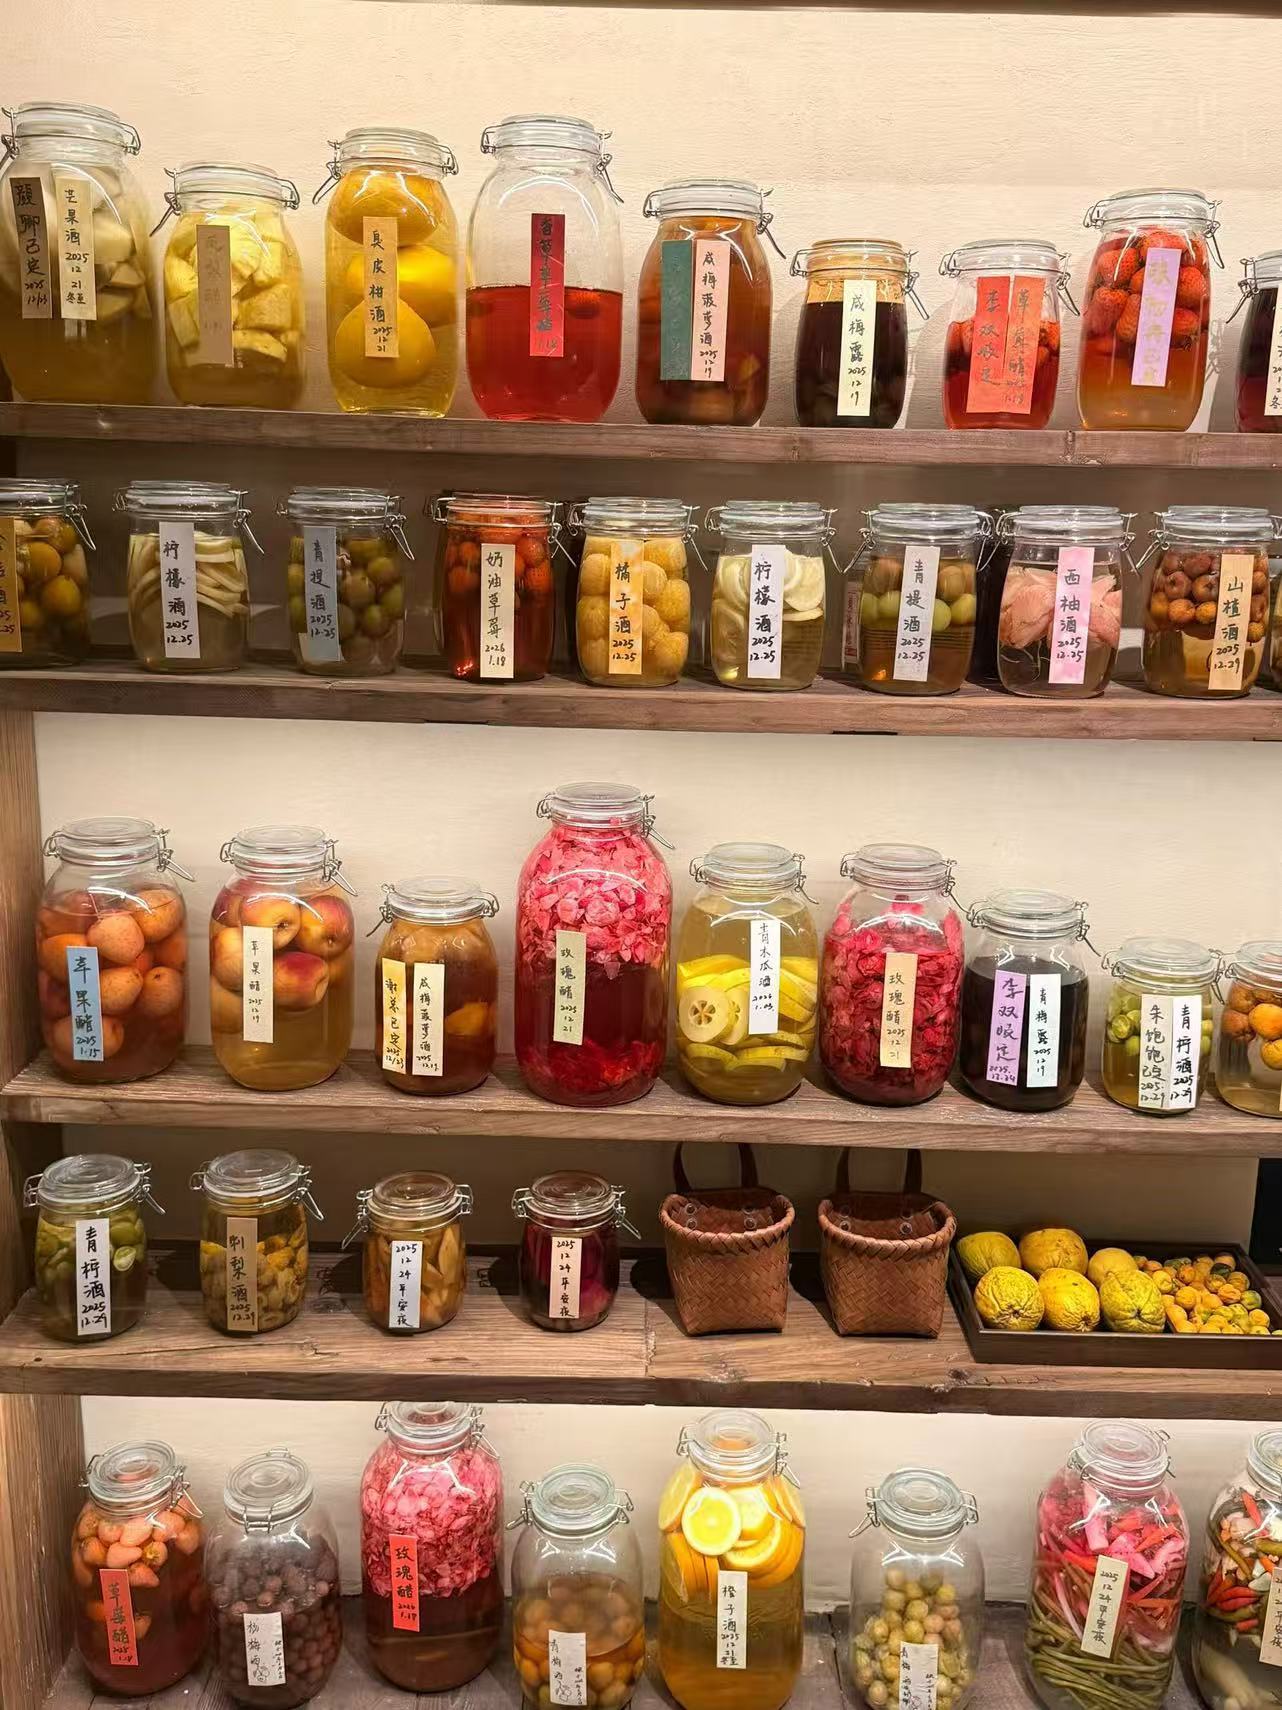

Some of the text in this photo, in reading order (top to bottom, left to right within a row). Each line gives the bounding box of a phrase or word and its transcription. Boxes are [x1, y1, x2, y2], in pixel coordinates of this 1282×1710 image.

[65, 252, 90, 262] 2025
[71, 265, 82, 273] 12
[71, 282, 82, 290] 21
[66, 292, 87, 306] 冬至
[373, 327, 392, 336] 2025
[377, 345, 387, 353] 21
[699, 351, 718, 359] 2025
[848, 367, 866, 376] 2025
[904, 559, 925, 632] 青提酒
[1060, 569, 1080, 634] 西柚酒
[166, 620, 189, 630] 2025
[310, 614, 333, 626] 2025
[167, 634, 193, 645] 12.25
[612, 639, 634, 650] 2025
[751, 635, 775, 648] 2025
[901, 638, 924, 648] 2025
[1057, 637, 1082, 648] 2025
[485, 643, 505, 652] 2026
[1216, 644, 1239, 655] 2025
[612, 653, 636, 662] 12.25
[750, 650, 776, 663] 12.25
[898, 651, 926, 662] 12.25
[1057, 651, 1084, 662] 12.25
[1213, 657, 1240, 674] 12.29
[248, 998, 262, 1006] 2025
[886, 972, 905, 1025] 玫瑰醋
[560, 1005, 577, 1014] 2025
[887, 1028, 906, 1036] 2025
[1173, 1076, 1193, 1086] 2025
[396, 1243, 418, 1254] 2025
[557, 1240, 575, 1249] 2025
[81, 1226, 106, 1299] 青柠酒
[559, 1264, 571, 1273] 24
[399, 1270, 411, 1279] 24
[82, 1301, 106, 1313] 2025
[230, 1303, 251, 1312] 2025
[81, 1313, 107, 1328] 12.29
[1100, 1570, 1119, 1582] 2025
[1098, 1594, 1112, 1604] 24
[721, 1633, 740, 1641] 2025
